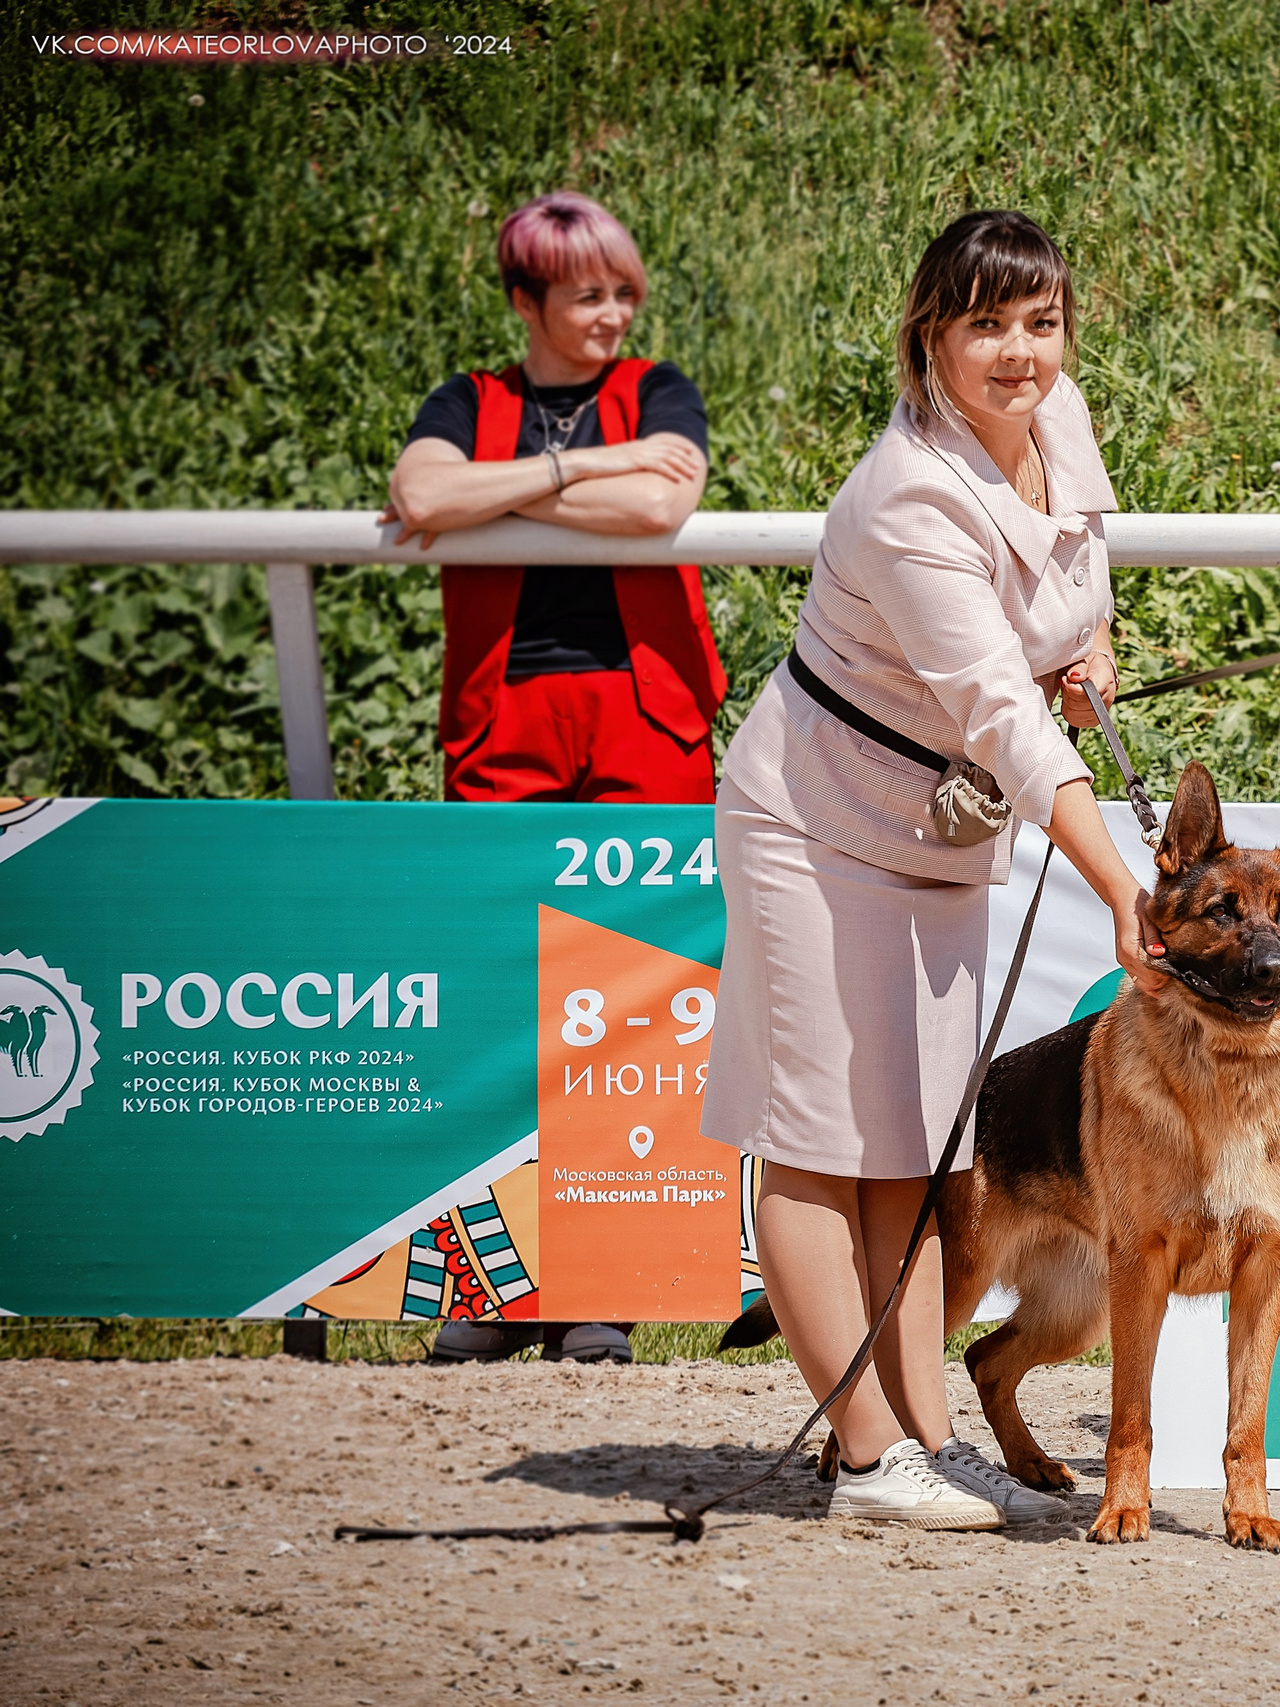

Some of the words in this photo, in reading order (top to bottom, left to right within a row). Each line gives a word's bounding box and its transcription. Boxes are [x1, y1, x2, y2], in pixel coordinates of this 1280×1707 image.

[554, 837, 718, 886] 2024
[121, 972, 438, 1029] РОССИЯ
[122, 1050, 226, 1065] «РОССИЯ.
[233, 1050, 301, 1065] КУБОК
[309, 1050, 351, 1065] РКФ
[357, 1050, 414, 1065] 2024»
[122, 1077, 226, 1092] «РОССИЯ.
[233, 1077, 301, 1092] КУБОК
[309, 1077, 400, 1092] МОСКВЫ
[407, 1077, 421, 1093] &
[122, 1098, 191, 1113] КУБОК
[199, 1098, 380, 1115] ГОРОДОВ-ГЕРОЕВ
[387, 1097, 443, 1112] 2024»
[553, 1167, 652, 1182] Московская
[657, 1165, 728, 1183] область,
[554, 1186, 659, 1203] «Максима
[662, 1185, 726, 1208] Парк»
